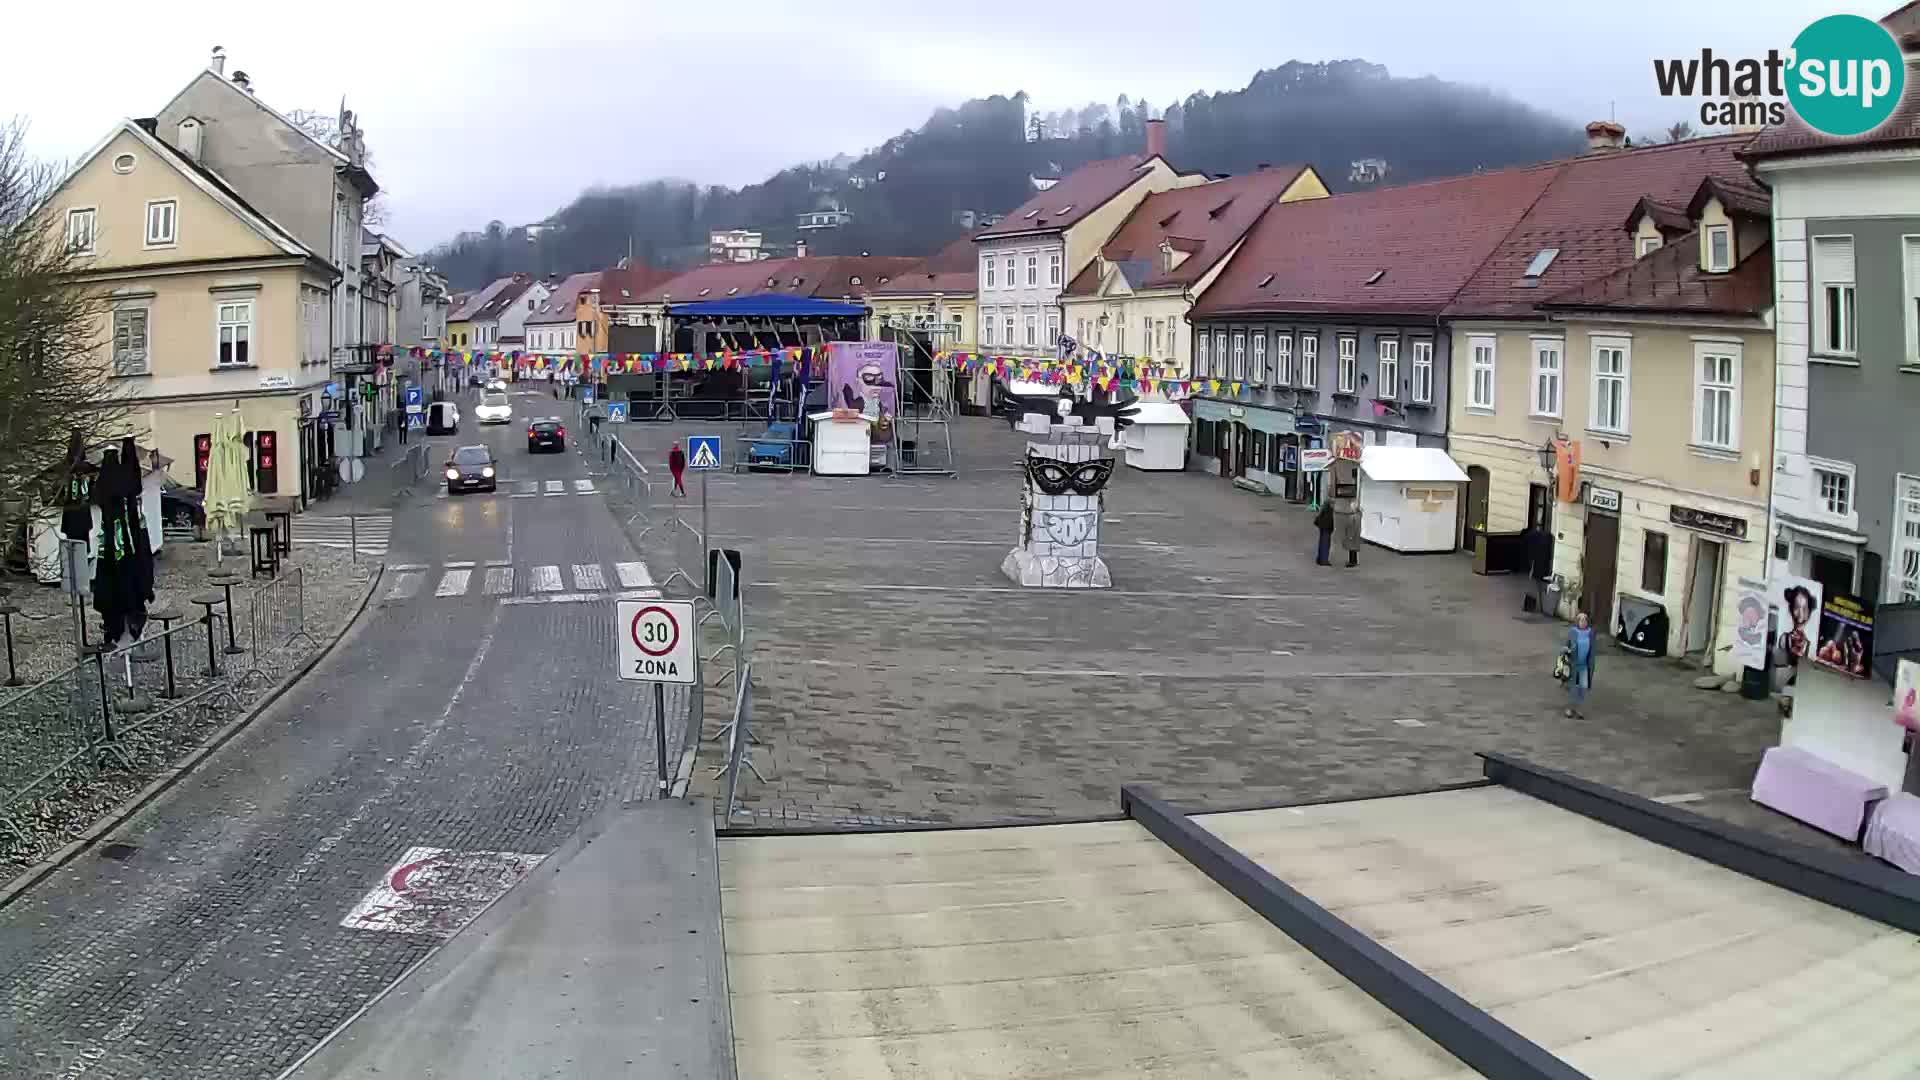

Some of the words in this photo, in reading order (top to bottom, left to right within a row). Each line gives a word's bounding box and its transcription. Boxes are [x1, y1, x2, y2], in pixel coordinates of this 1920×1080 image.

[410, 391, 418, 403] P
[644, 622, 668, 643] 30
[634, 659, 678, 676] ZONA
